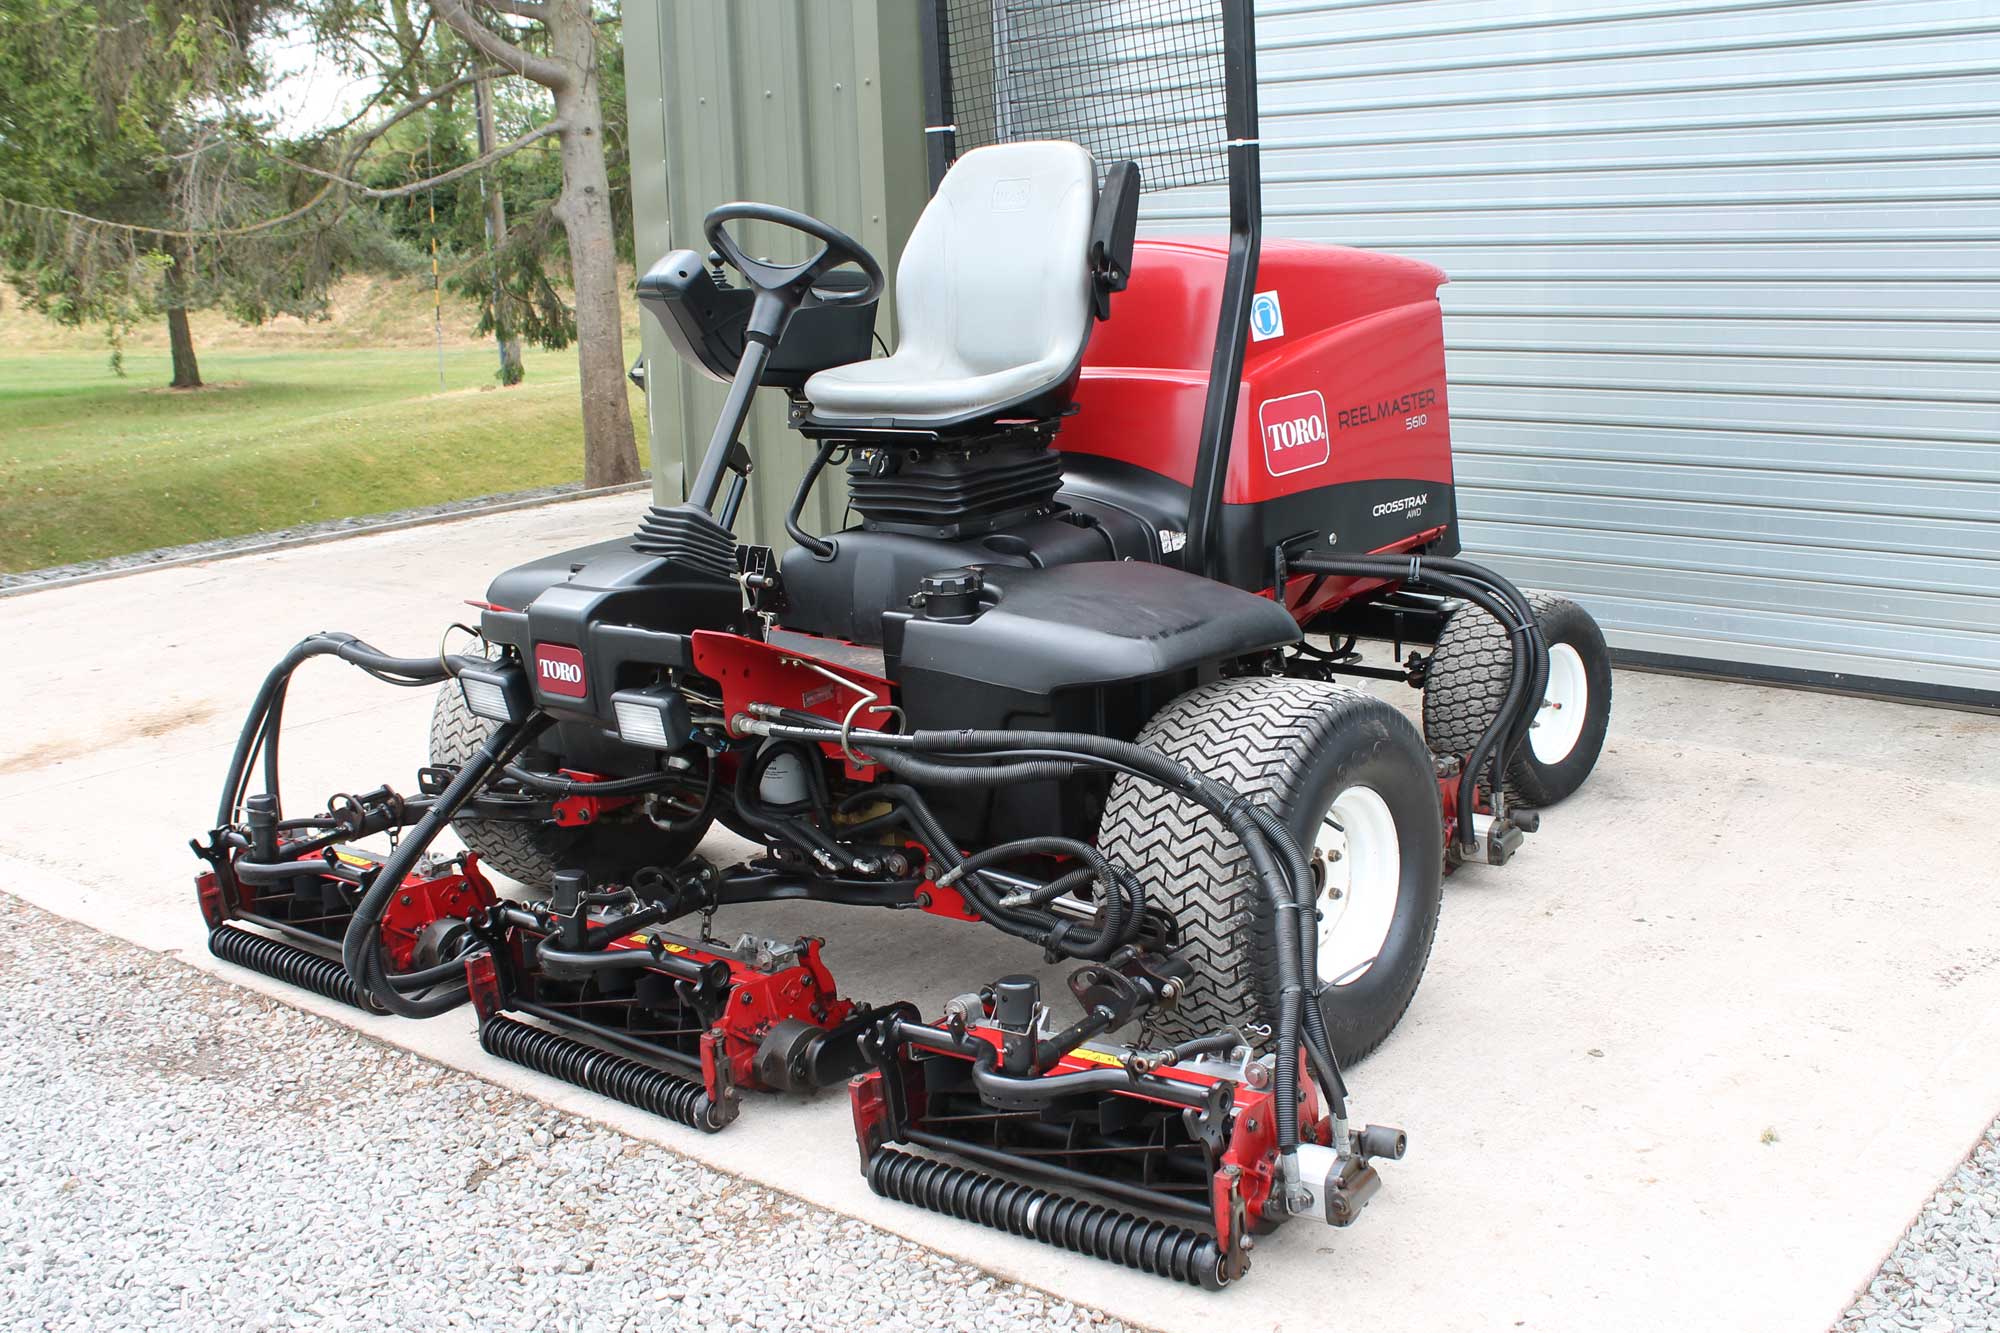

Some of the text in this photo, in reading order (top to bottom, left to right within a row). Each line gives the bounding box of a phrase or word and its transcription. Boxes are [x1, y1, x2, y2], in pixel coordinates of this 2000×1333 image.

[1338, 388, 1435, 429] REELMASTER
[1267, 415, 1322, 451] TORO
[1405, 413, 1427, 430] 5610
[1372, 493, 1428, 517] CROSSTRAX
[1406, 507, 1422, 519] AWD
[539, 658, 582, 683] TORO
